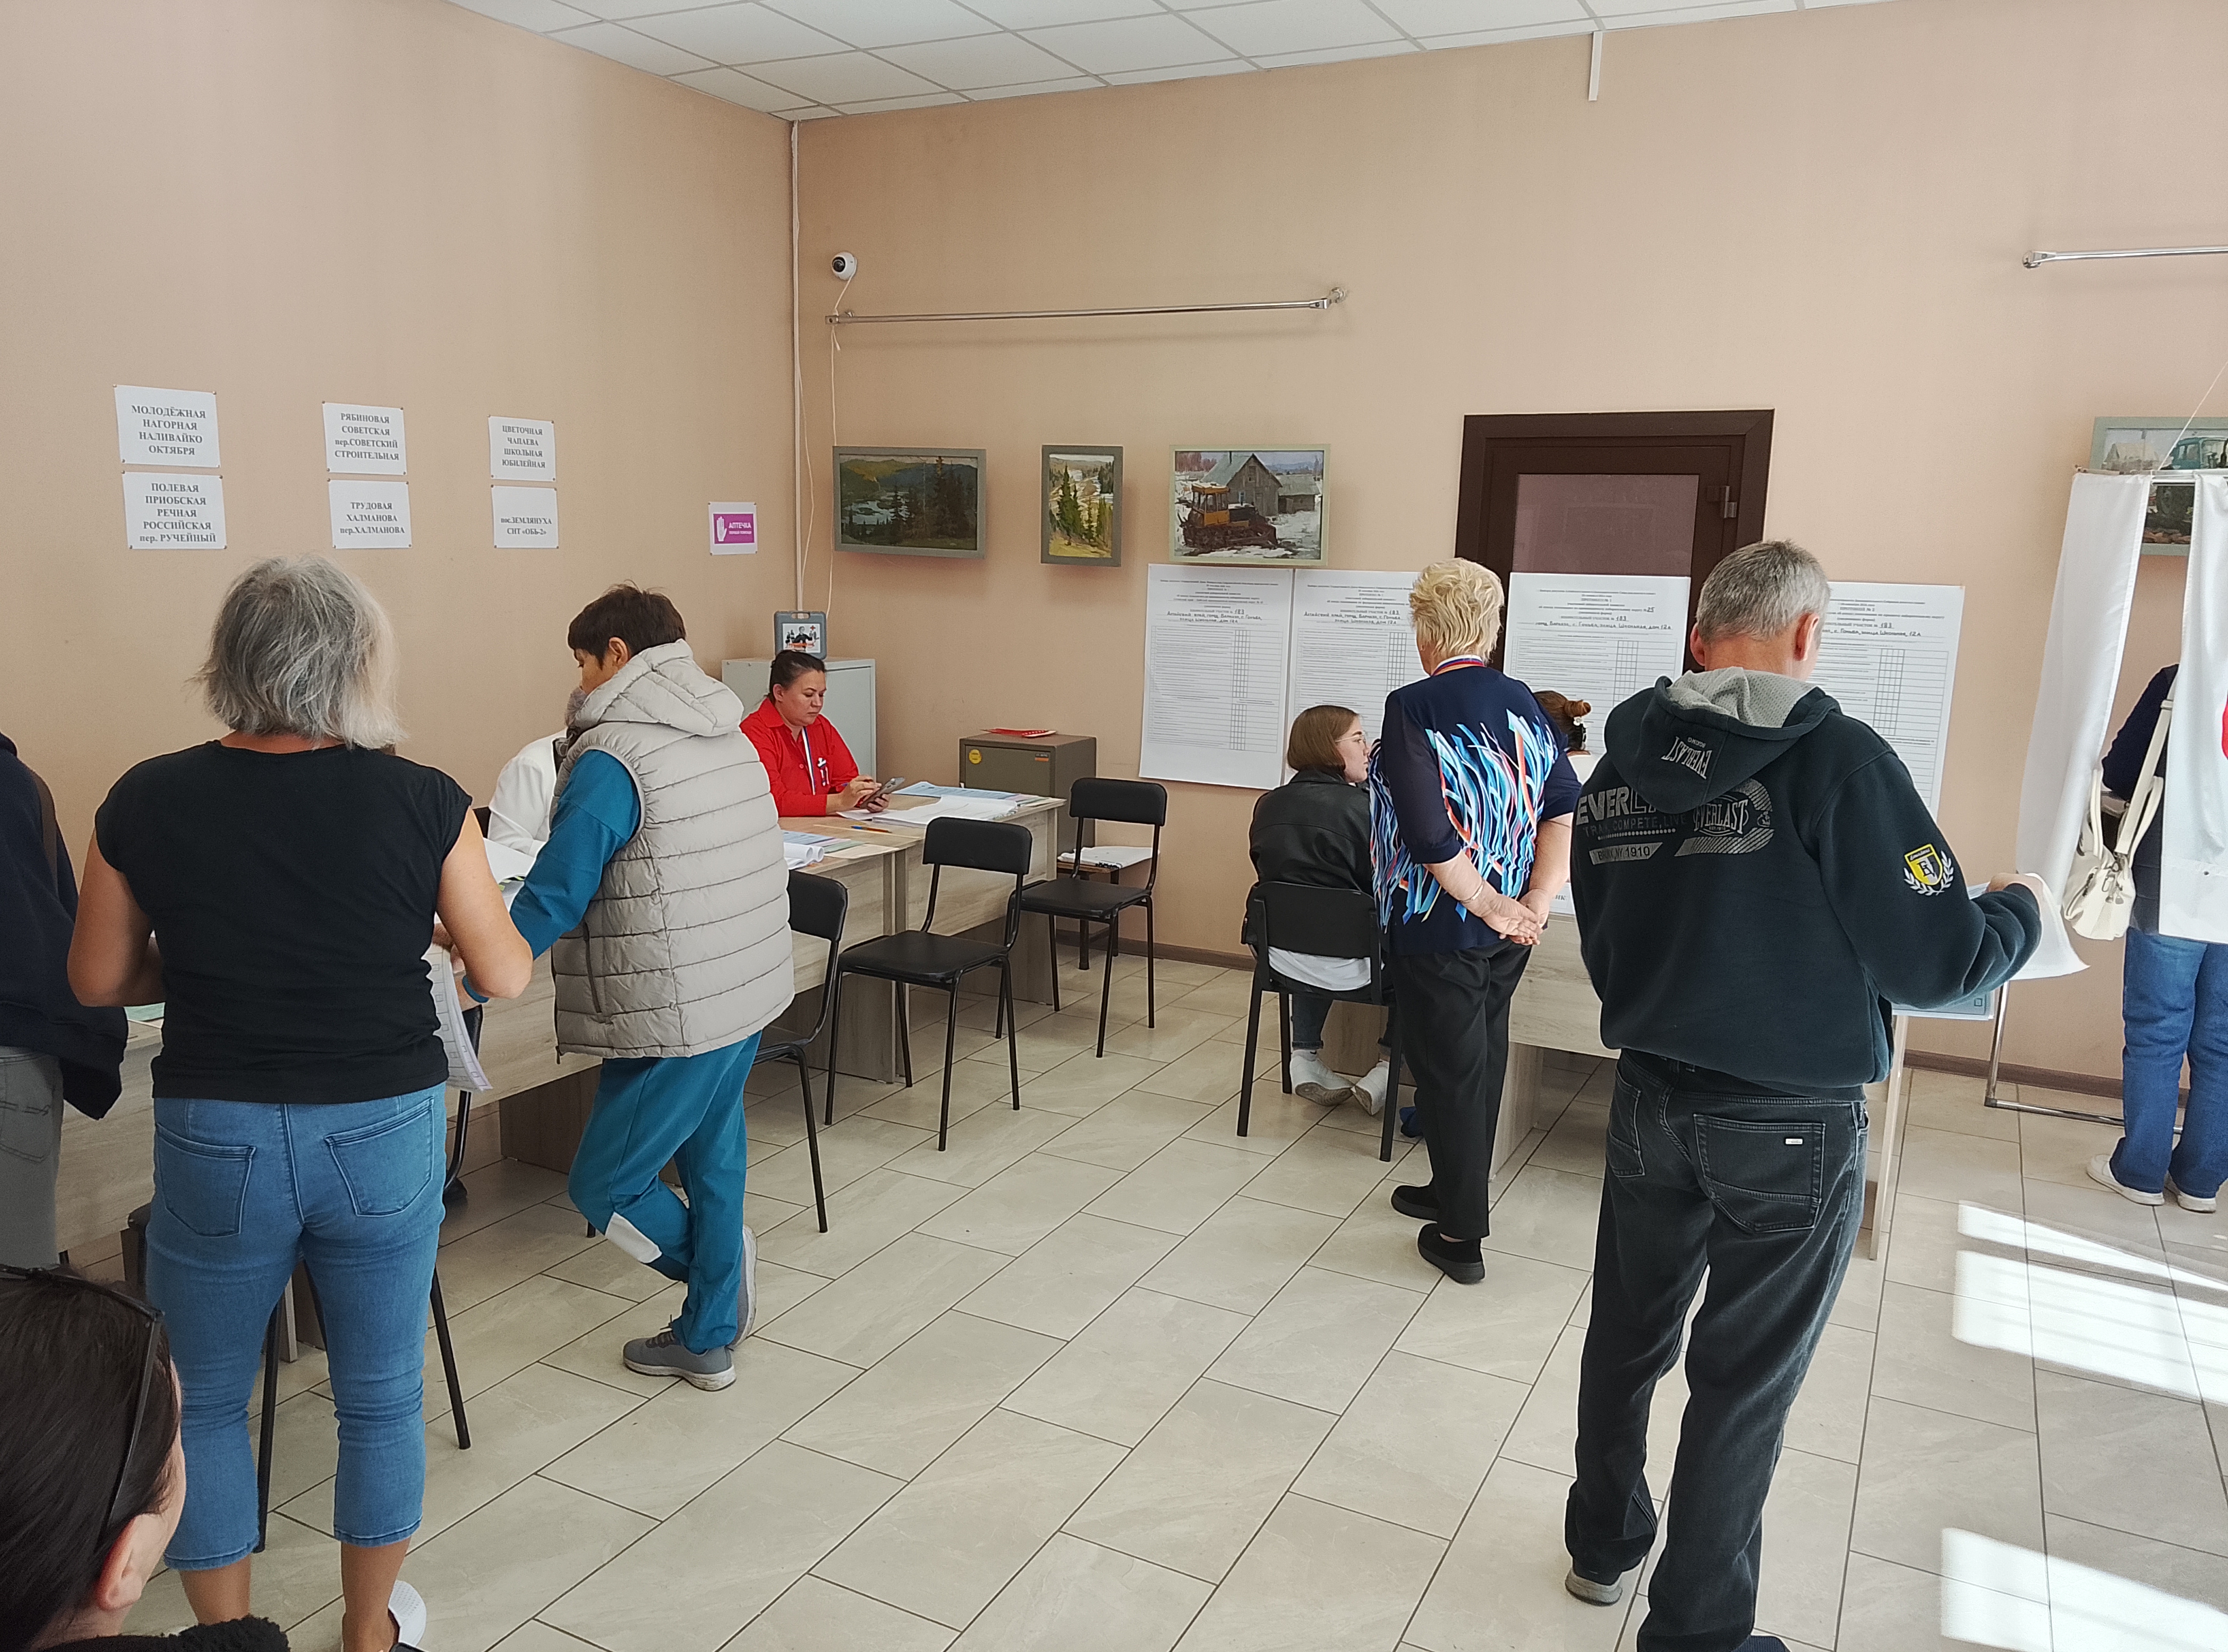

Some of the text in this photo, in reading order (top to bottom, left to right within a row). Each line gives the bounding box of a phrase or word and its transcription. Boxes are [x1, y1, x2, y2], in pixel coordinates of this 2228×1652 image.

[131, 405, 206, 419] МОЛОДЁЖНАЯ
[340, 412, 390, 424] РЯБИНОВАЯ
[142, 419, 197, 430] НАГОРНАЯ
[342, 425, 390, 436] СОВЕТСКАЯ
[502, 425, 543, 435] ЦВЕТОЧНАЯ
[139, 432, 203, 443] НАЛИВАЙКО
[507, 437, 539, 446] ЧАПАЕВА
[148, 445, 195, 455] ОКТЯБРЯ
[504, 448, 543, 457] ШКОЛЬНАЯ
[335, 450, 399, 461] СТРОИТЕЛЬНАЯ
[502, 459, 545, 468] ЮБИЛЕЙНАЯ
[151, 483, 199, 492] ПОЛЕВАЯ
[145, 496, 206, 505] ПРИОБСКАЯ
[157, 508, 197, 517] РЕЧНАЯ
[143, 520, 211, 530] РОССИЙСКАЯ
[160, 533, 216, 542] РУЧЕЙНЫЙ
[1661, 736, 1712, 780] EVERLAST
[1576, 786, 1656, 825] EVERL
[1694, 799, 1749, 834] EVERLAST
[1625, 846, 1650, 857] 1910
